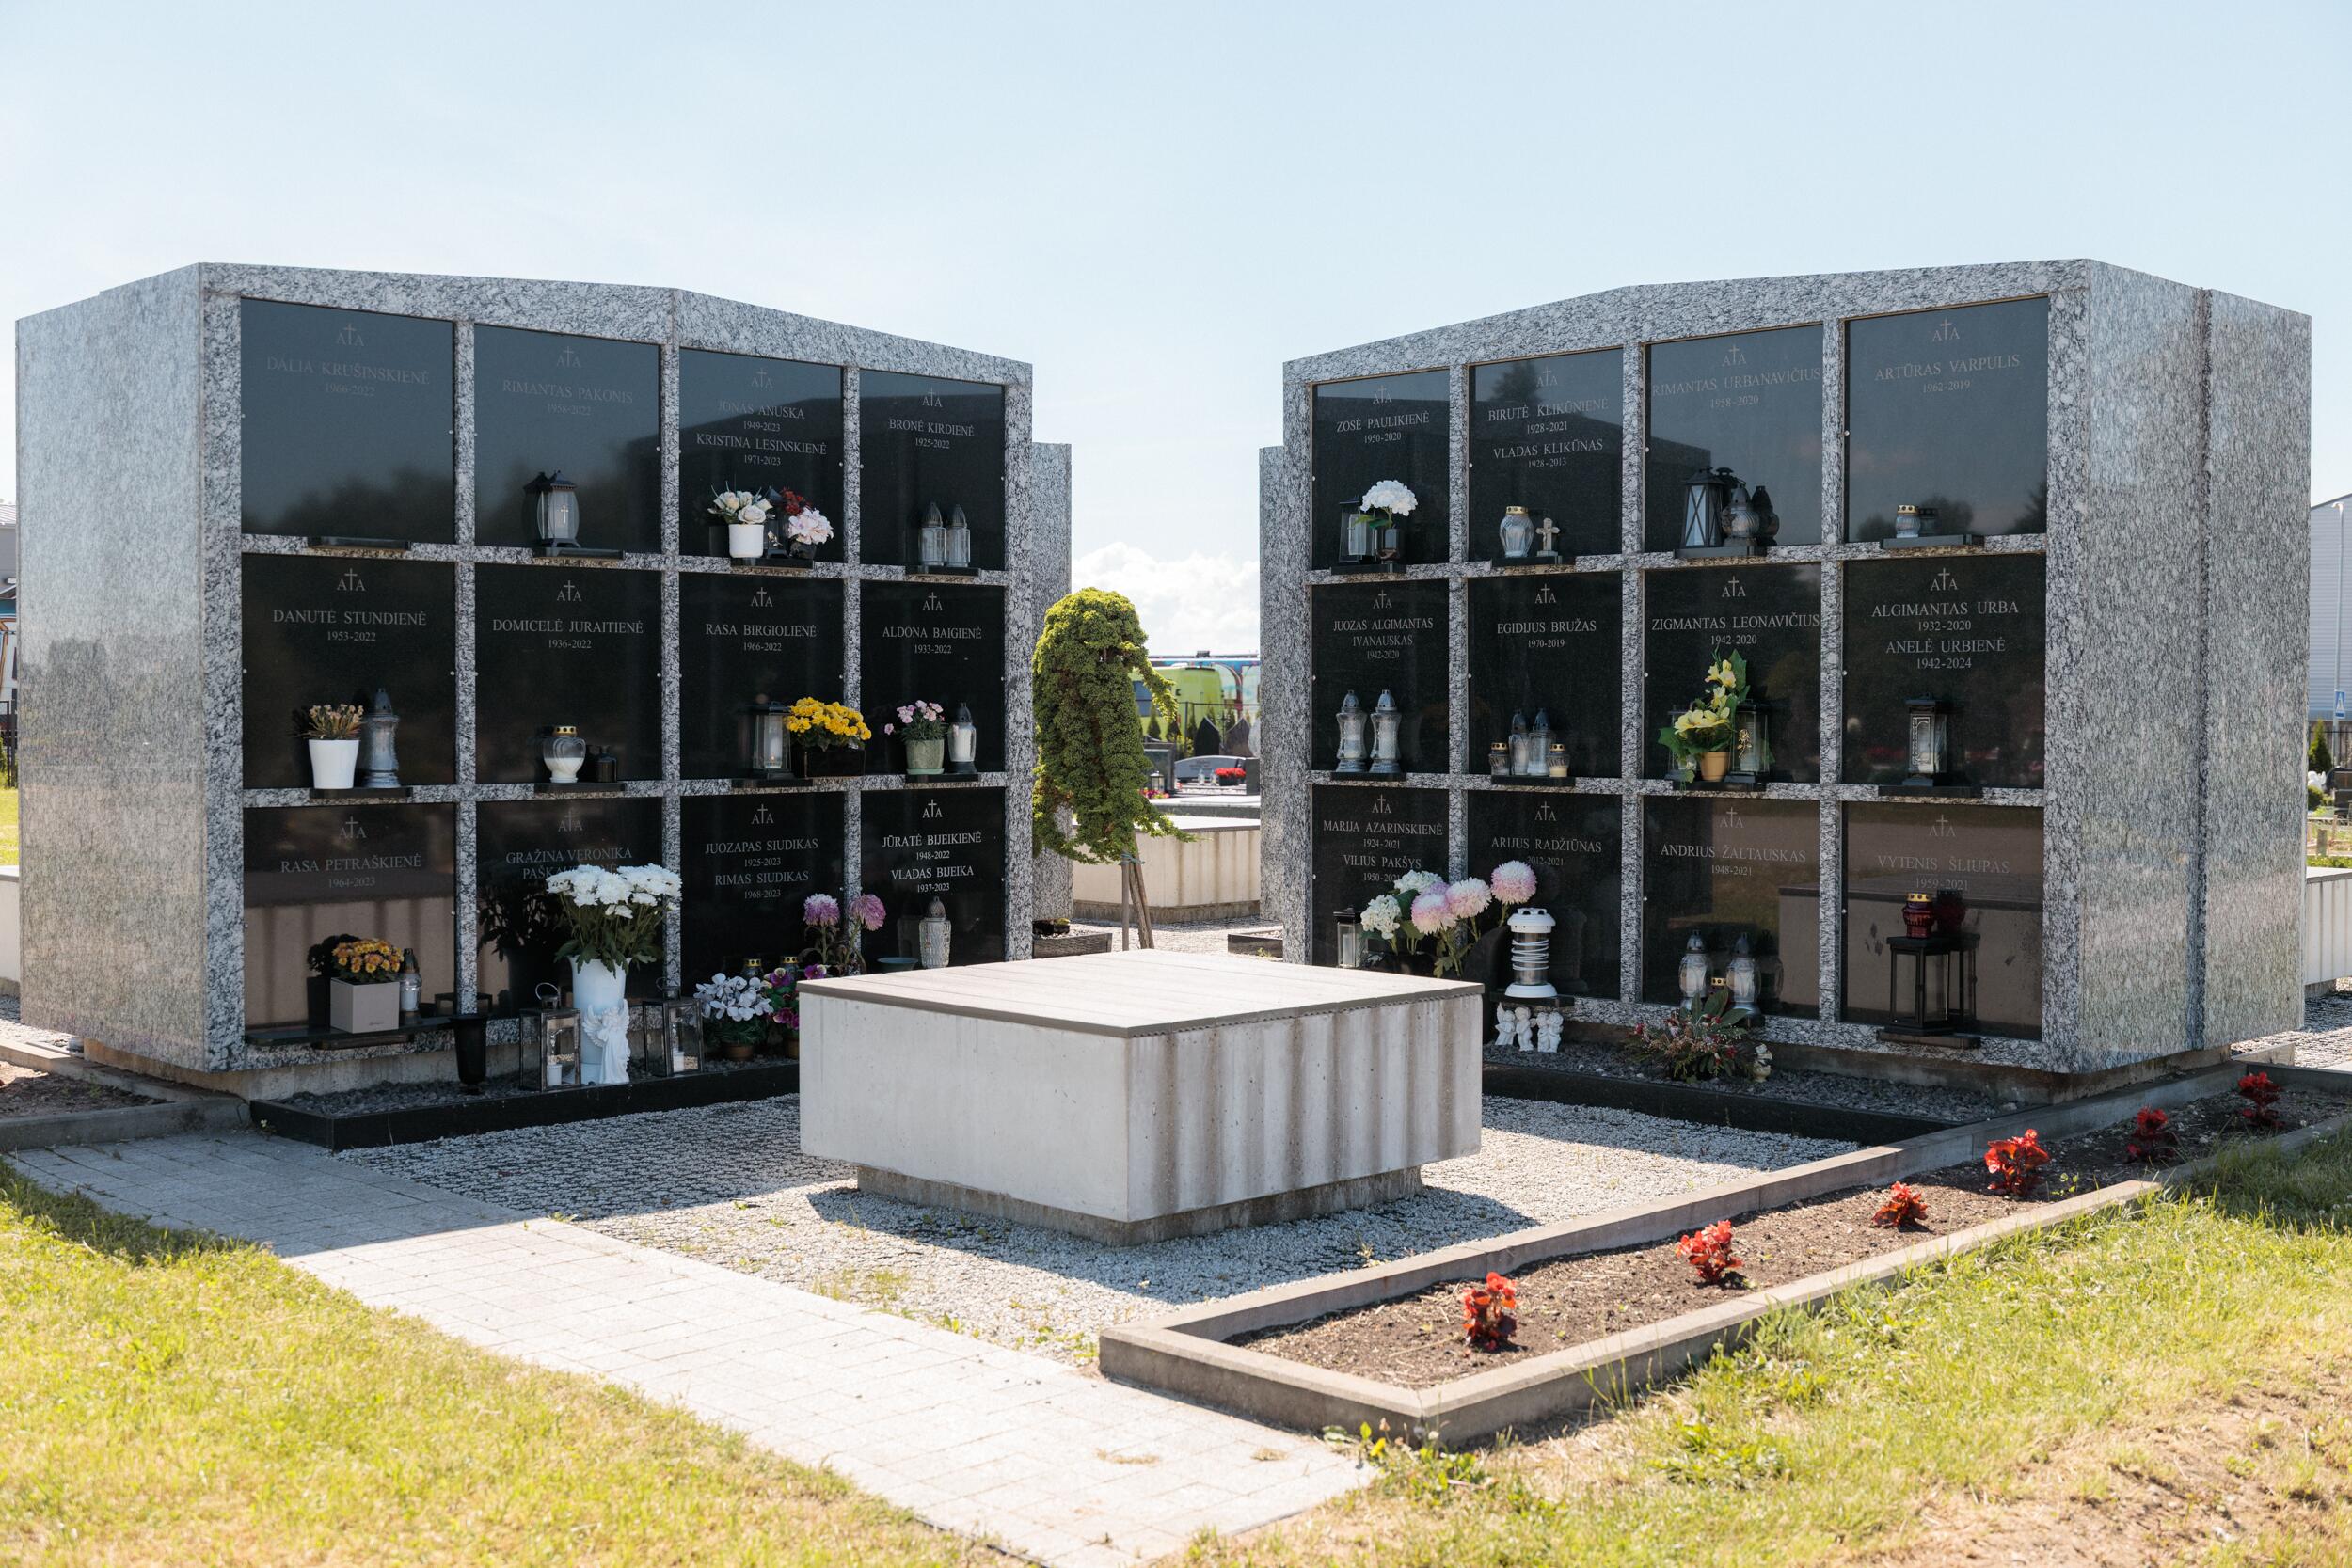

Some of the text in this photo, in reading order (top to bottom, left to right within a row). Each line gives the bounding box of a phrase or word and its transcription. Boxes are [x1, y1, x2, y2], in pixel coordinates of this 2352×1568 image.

[267, 356, 314, 373] DALIA
[1875, 355, 2021, 381] ARTŪRAS VARPULIS
[1653, 368, 1821, 396] RIMANTAS URBANAVIČIUS
[503, 380, 633, 404] RIMANTAS PAKONIS
[719, 401, 754, 414] JONAS
[1489, 404, 1529, 421] BIRUTĖ
[743, 421, 780, 432] 1949-2023
[890, 419, 975, 436] BRONĖ KIRDIENĖ
[1337, 410, 1430, 433] ZOSĖ PAULIKIENĖ
[1527, 421, 1567, 435] 1928-2021
[697, 434, 827, 454] KRISTINA LESINSKIENĖ
[915, 438, 949, 449] 1925-2022
[1364, 432, 1402, 444] 1950-2020
[1494, 439, 1603, 459] VLADAS KLIKŪNAS
[744, 455, 781, 466] 1971-2023
[1528, 457, 1566, 468] 1928-2013
[1871, 601, 2019, 617] ALGIMANTAS URBA
[273, 610, 427, 626] DANUTĖ STUNDIENĖ
[1333, 617, 1434, 631] JUOZAS ALGIMANTAS
[1652, 612, 1820, 630] ZIGMANTAS LEONAVIČIUS
[493, 619, 644, 634] DOMICELĖ JURAITIENĖ
[706, 624, 817, 637] RASA BIRGIOLIENĖ
[882, 626, 981, 639] ALDONA BAIGIENĖ
[1498, 618, 1597, 634] EGIDIJUS BRUŽAS
[1918, 620, 1971, 631] 1932-2020
[327, 632, 376, 641] 1953-2022
[1353, 635, 1413, 646] IVANAUSKAS
[548, 640, 592, 649] 1936-2022
[914, 644, 951, 654] 1933-2022
[1528, 640, 1565, 648] 1970-2019
[1886, 637, 2005, 654] ANELĖ URBIENĖ
[1917, 658, 1972, 669] 1942-2024
[1324, 820, 1442, 835] MARIJA AZARINSKIENĖ
[706, 838, 818, 854] JUOZAPAS SIUDIKAS
[882, 831, 982, 847] JŪRATĖ BIJEIKIENĖ
[1363, 839, 1400, 849] 1924-2021
[1492, 837, 1601, 853] ARIJUS RADŽIŪNAS
[506, 847, 632, 864] GRAŽINA VERONIKA
[916, 851, 950, 861] 1948-2022
[1661, 844, 1806, 863] ANDRIUS ŽALTAUSKAS
[281, 853, 422, 873] RASA PETRAŠKIENĖ
[744, 858, 781, 867] 1925-2023
[1343, 855, 1422, 869] VILIUS PAKŠYS
[1878, 855, 2010, 874] VYTENIS ŠLIUPAS
[891, 865, 974, 880] VLADAS BIJEIKA
[1711, 865, 1752, 876] 1948-2021
[715, 871, 809, 886] RIMAS SIUDIKAS
[1916, 878, 1968, 890] 1959-2021
[744, 890, 781, 899] 1968-2023
[917, 883, 949, 893] 1937-2023
